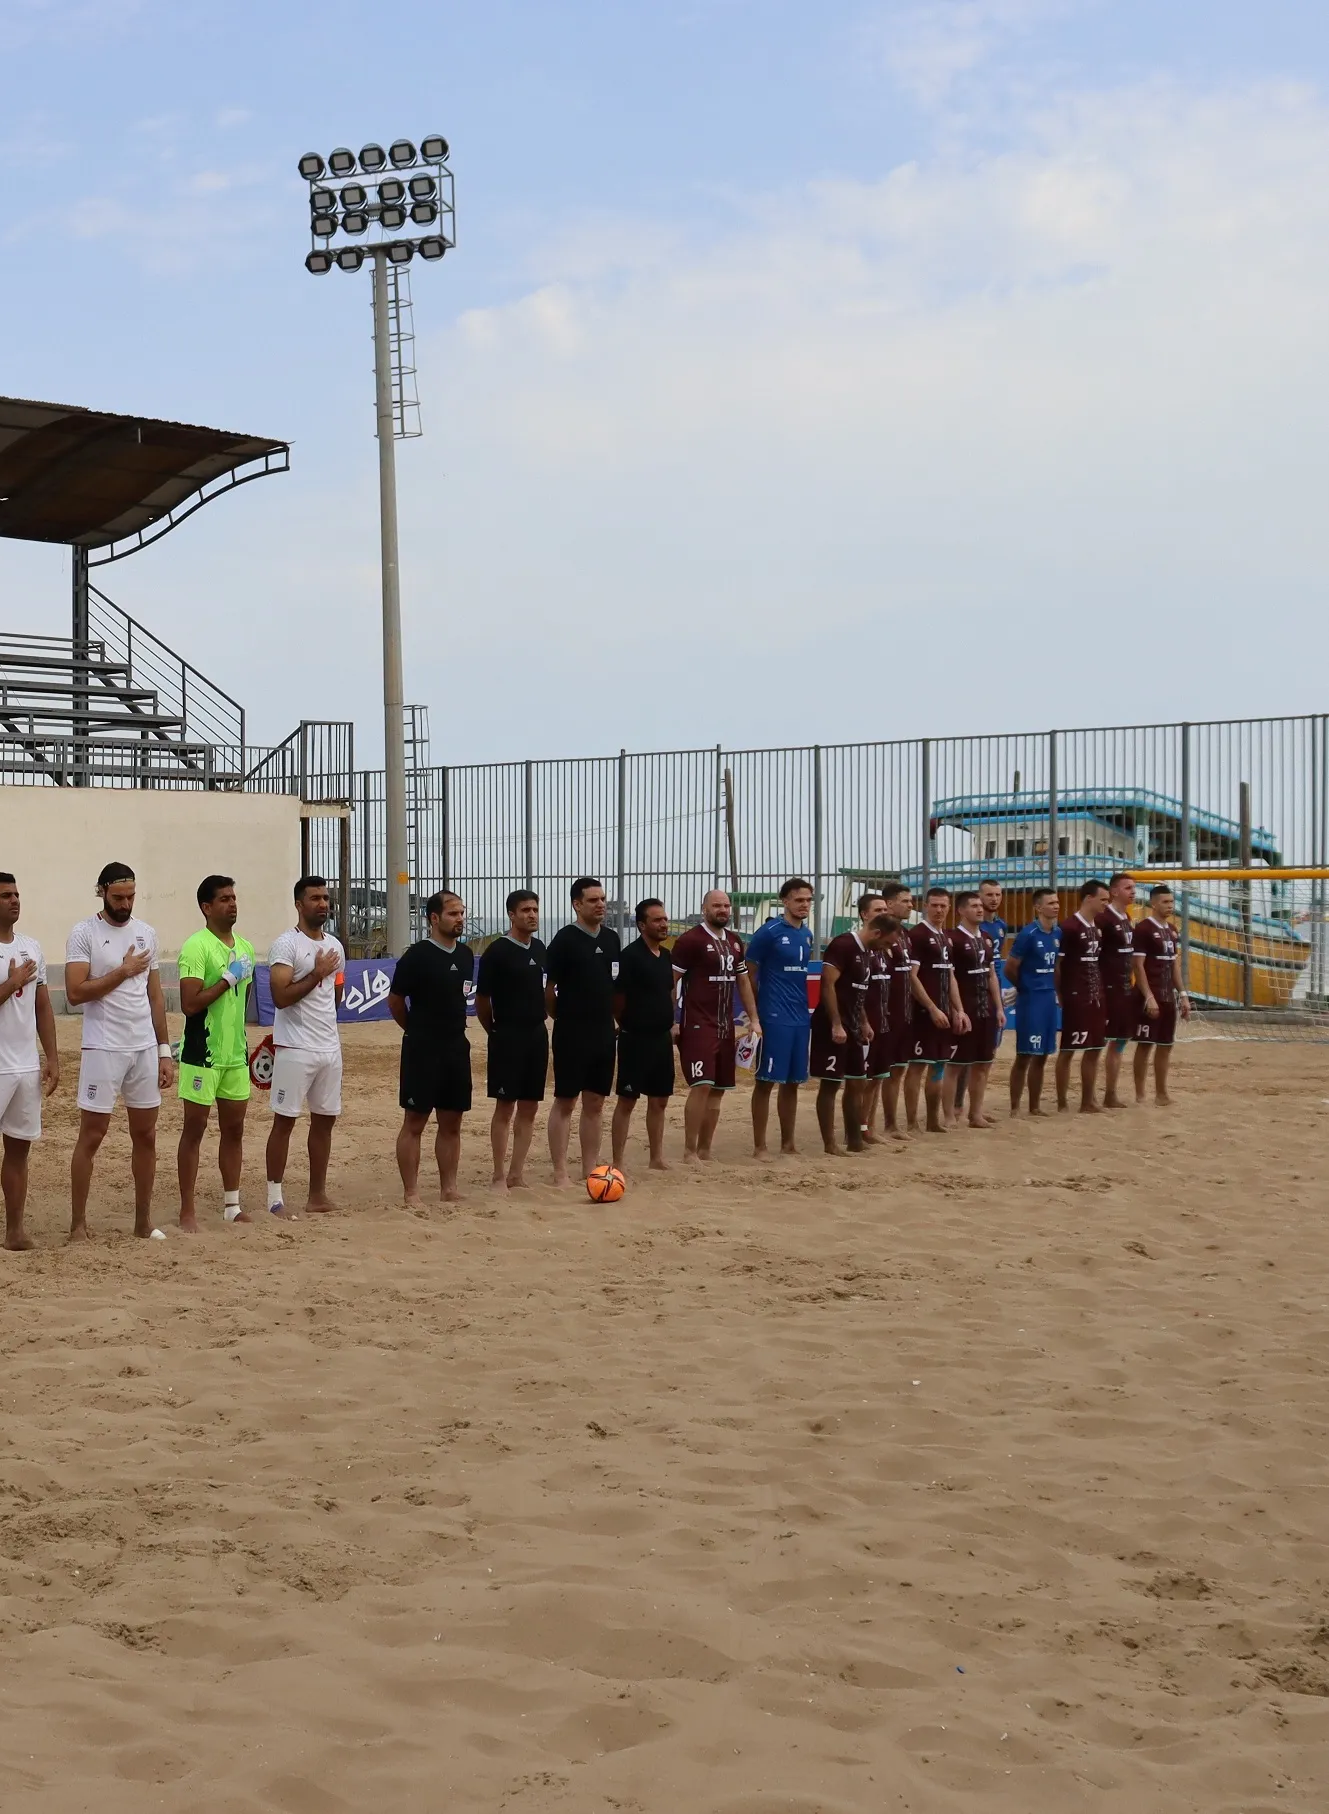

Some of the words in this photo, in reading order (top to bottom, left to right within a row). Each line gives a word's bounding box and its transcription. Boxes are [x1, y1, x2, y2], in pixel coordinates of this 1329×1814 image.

[942, 946, 949, 960] 6
[978, 949, 986, 963] 7
[720, 954, 734, 971] 18
[1071, 1031, 1088, 1045] 27
[1136, 1024, 1150, 1038] 19
[914, 1040, 923, 1056] 6
[1029, 1035, 1042, 1049] 99
[950, 1045, 959, 1059] 7
[691, 1060, 704, 1078] 18
[825, 1055, 837, 1072] 2
